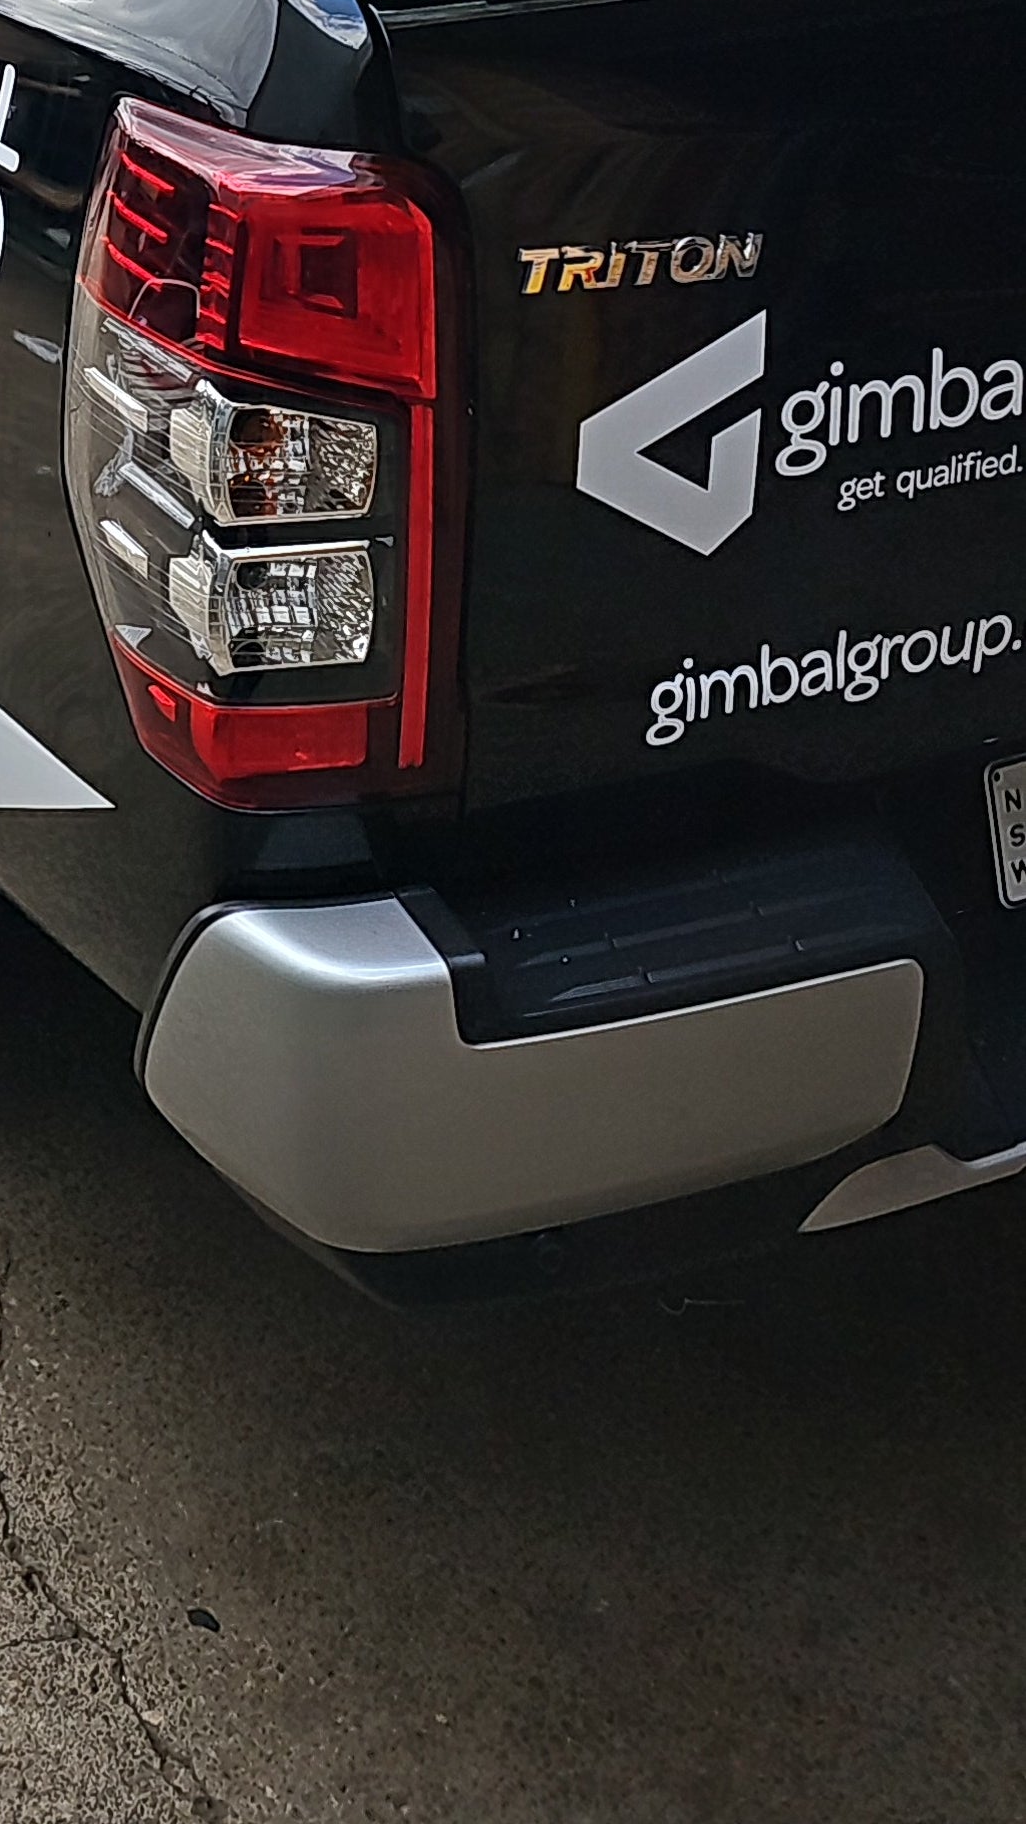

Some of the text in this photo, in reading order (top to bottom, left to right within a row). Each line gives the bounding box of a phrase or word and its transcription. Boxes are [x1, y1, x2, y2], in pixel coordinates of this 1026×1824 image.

[518, 232, 764, 295] TRITON
[837, 444, 1023, 511] get qualified.
